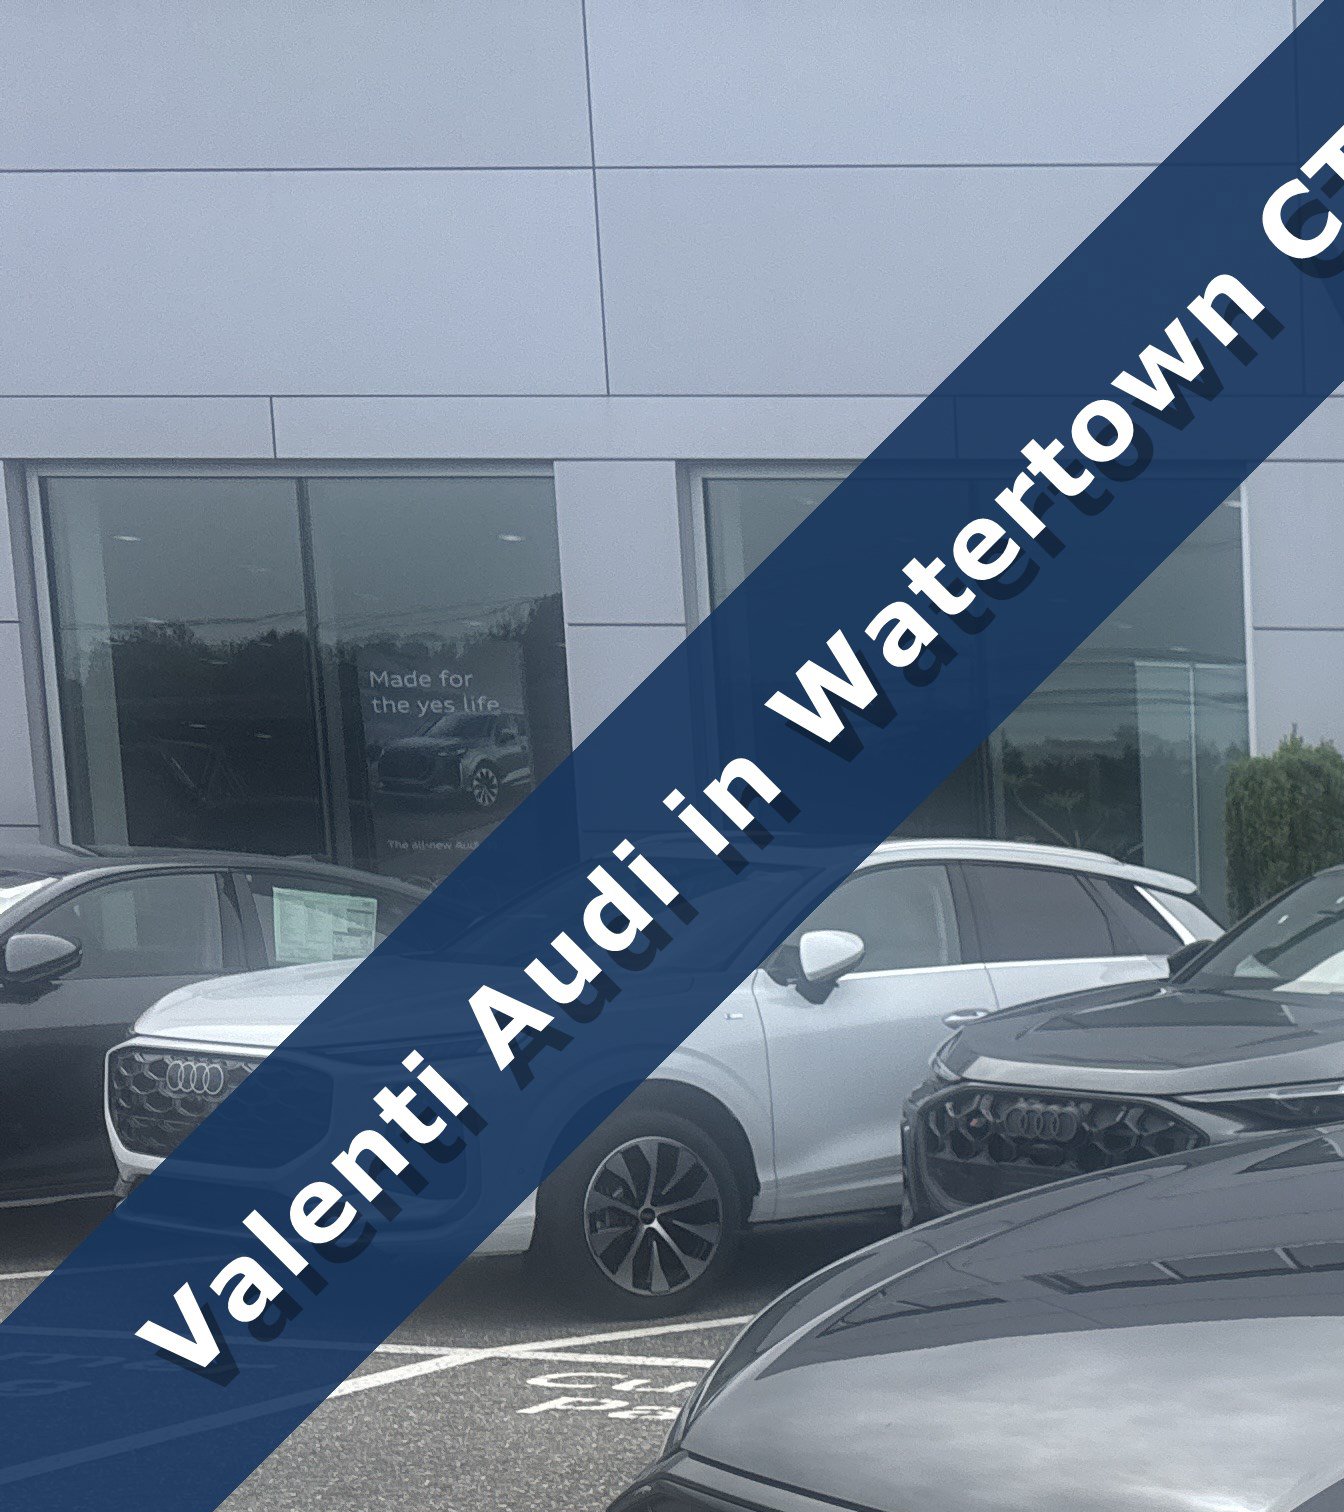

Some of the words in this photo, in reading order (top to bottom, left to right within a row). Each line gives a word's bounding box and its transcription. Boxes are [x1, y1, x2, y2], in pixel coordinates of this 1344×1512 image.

[369, 670, 432, 688] Made
[439, 670, 474, 688] for
[372, 696, 410, 714] the
[417, 699, 456, 718] yes
[463, 695, 501, 713] life
